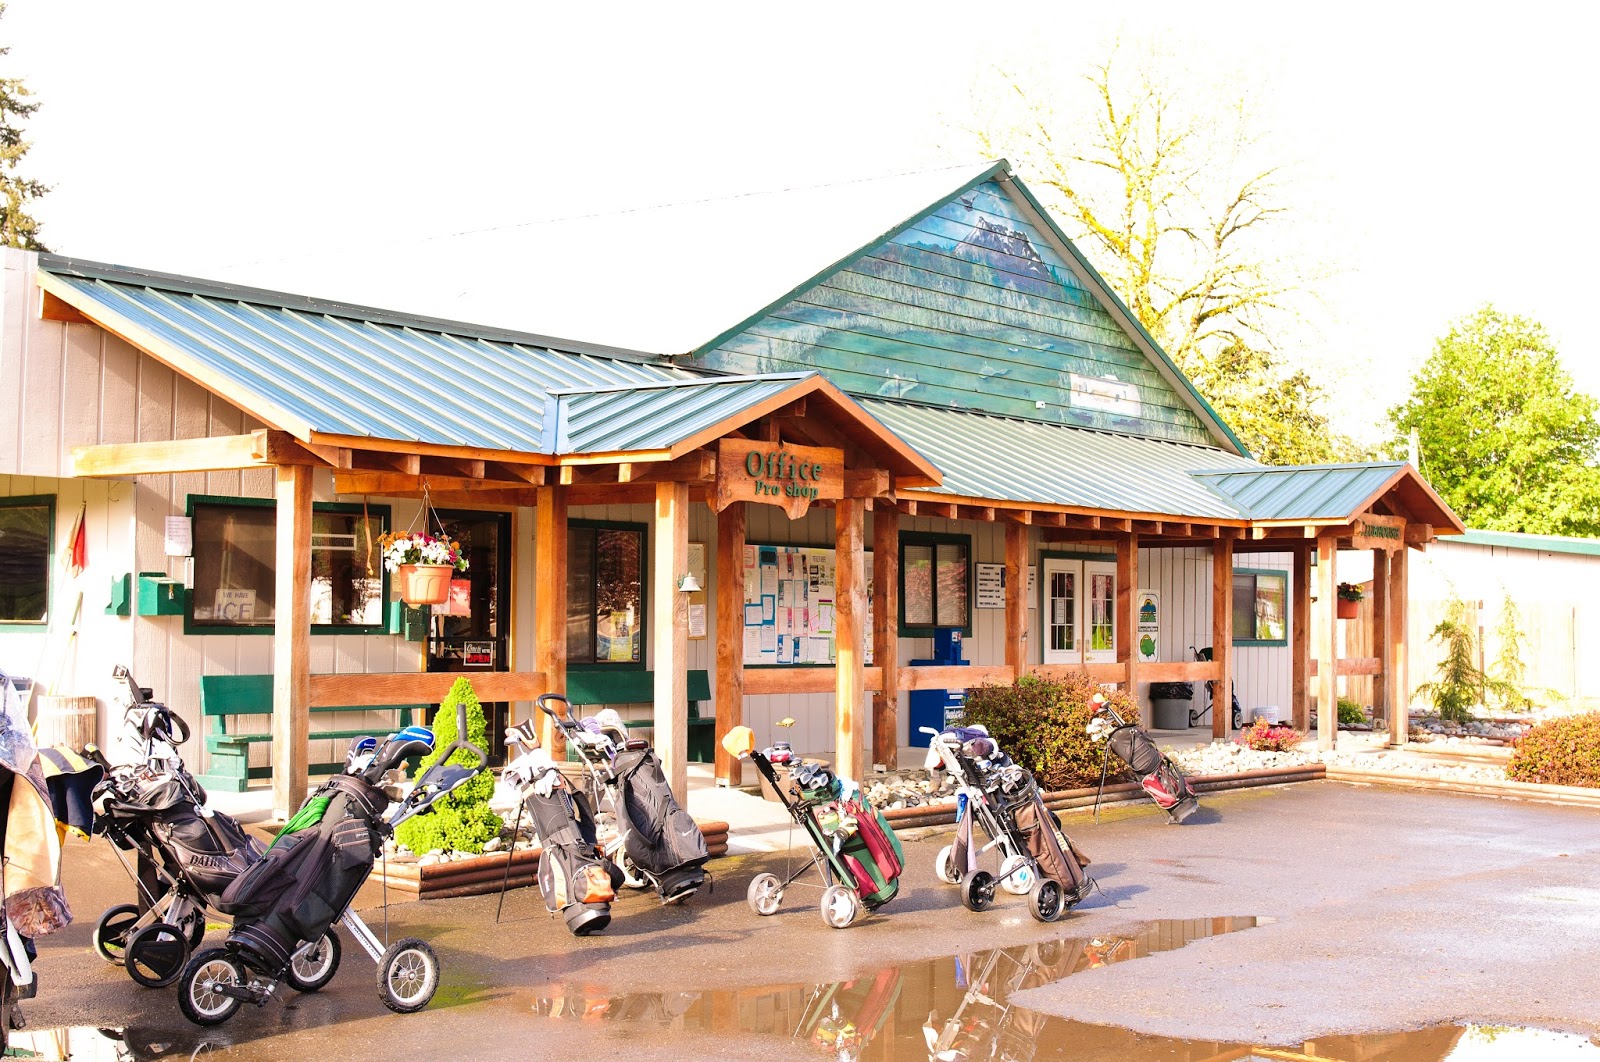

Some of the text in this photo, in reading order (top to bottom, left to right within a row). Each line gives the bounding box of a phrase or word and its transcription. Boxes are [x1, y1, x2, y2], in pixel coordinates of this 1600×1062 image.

[746, 450, 822, 481] Office
[755, 480, 819, 501] Pro shop
[466, 654, 490, 663] OPEN
